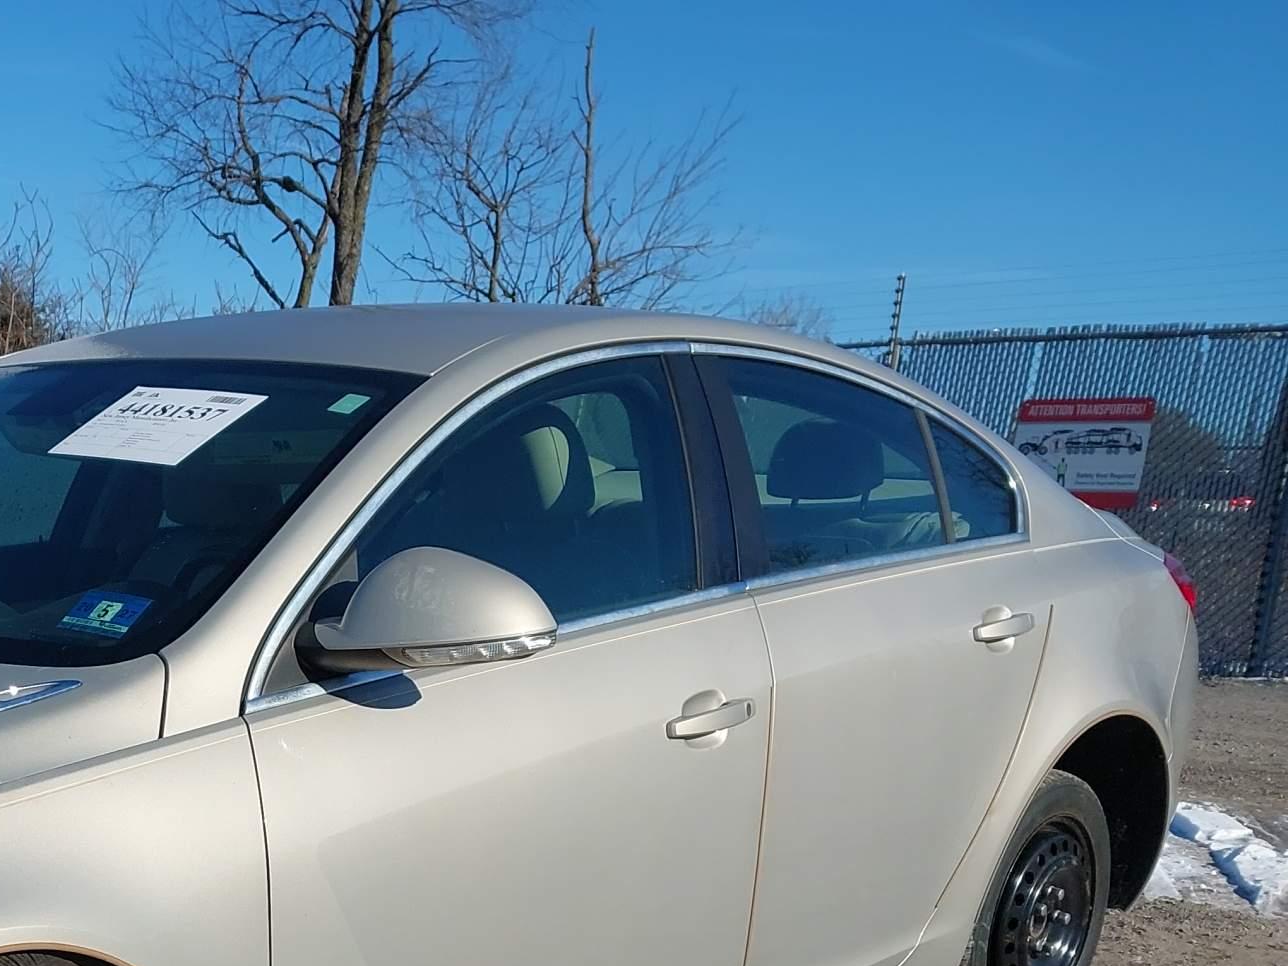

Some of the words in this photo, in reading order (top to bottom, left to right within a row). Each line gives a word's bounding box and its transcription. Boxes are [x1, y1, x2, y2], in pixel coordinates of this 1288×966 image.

[118, 402, 229, 421] 44181537
[1028, 404, 1074, 416] ATTENTION
[1076, 403, 1147, 415] TRANSPORTERS!
[97, 604, 114, 618] 5
